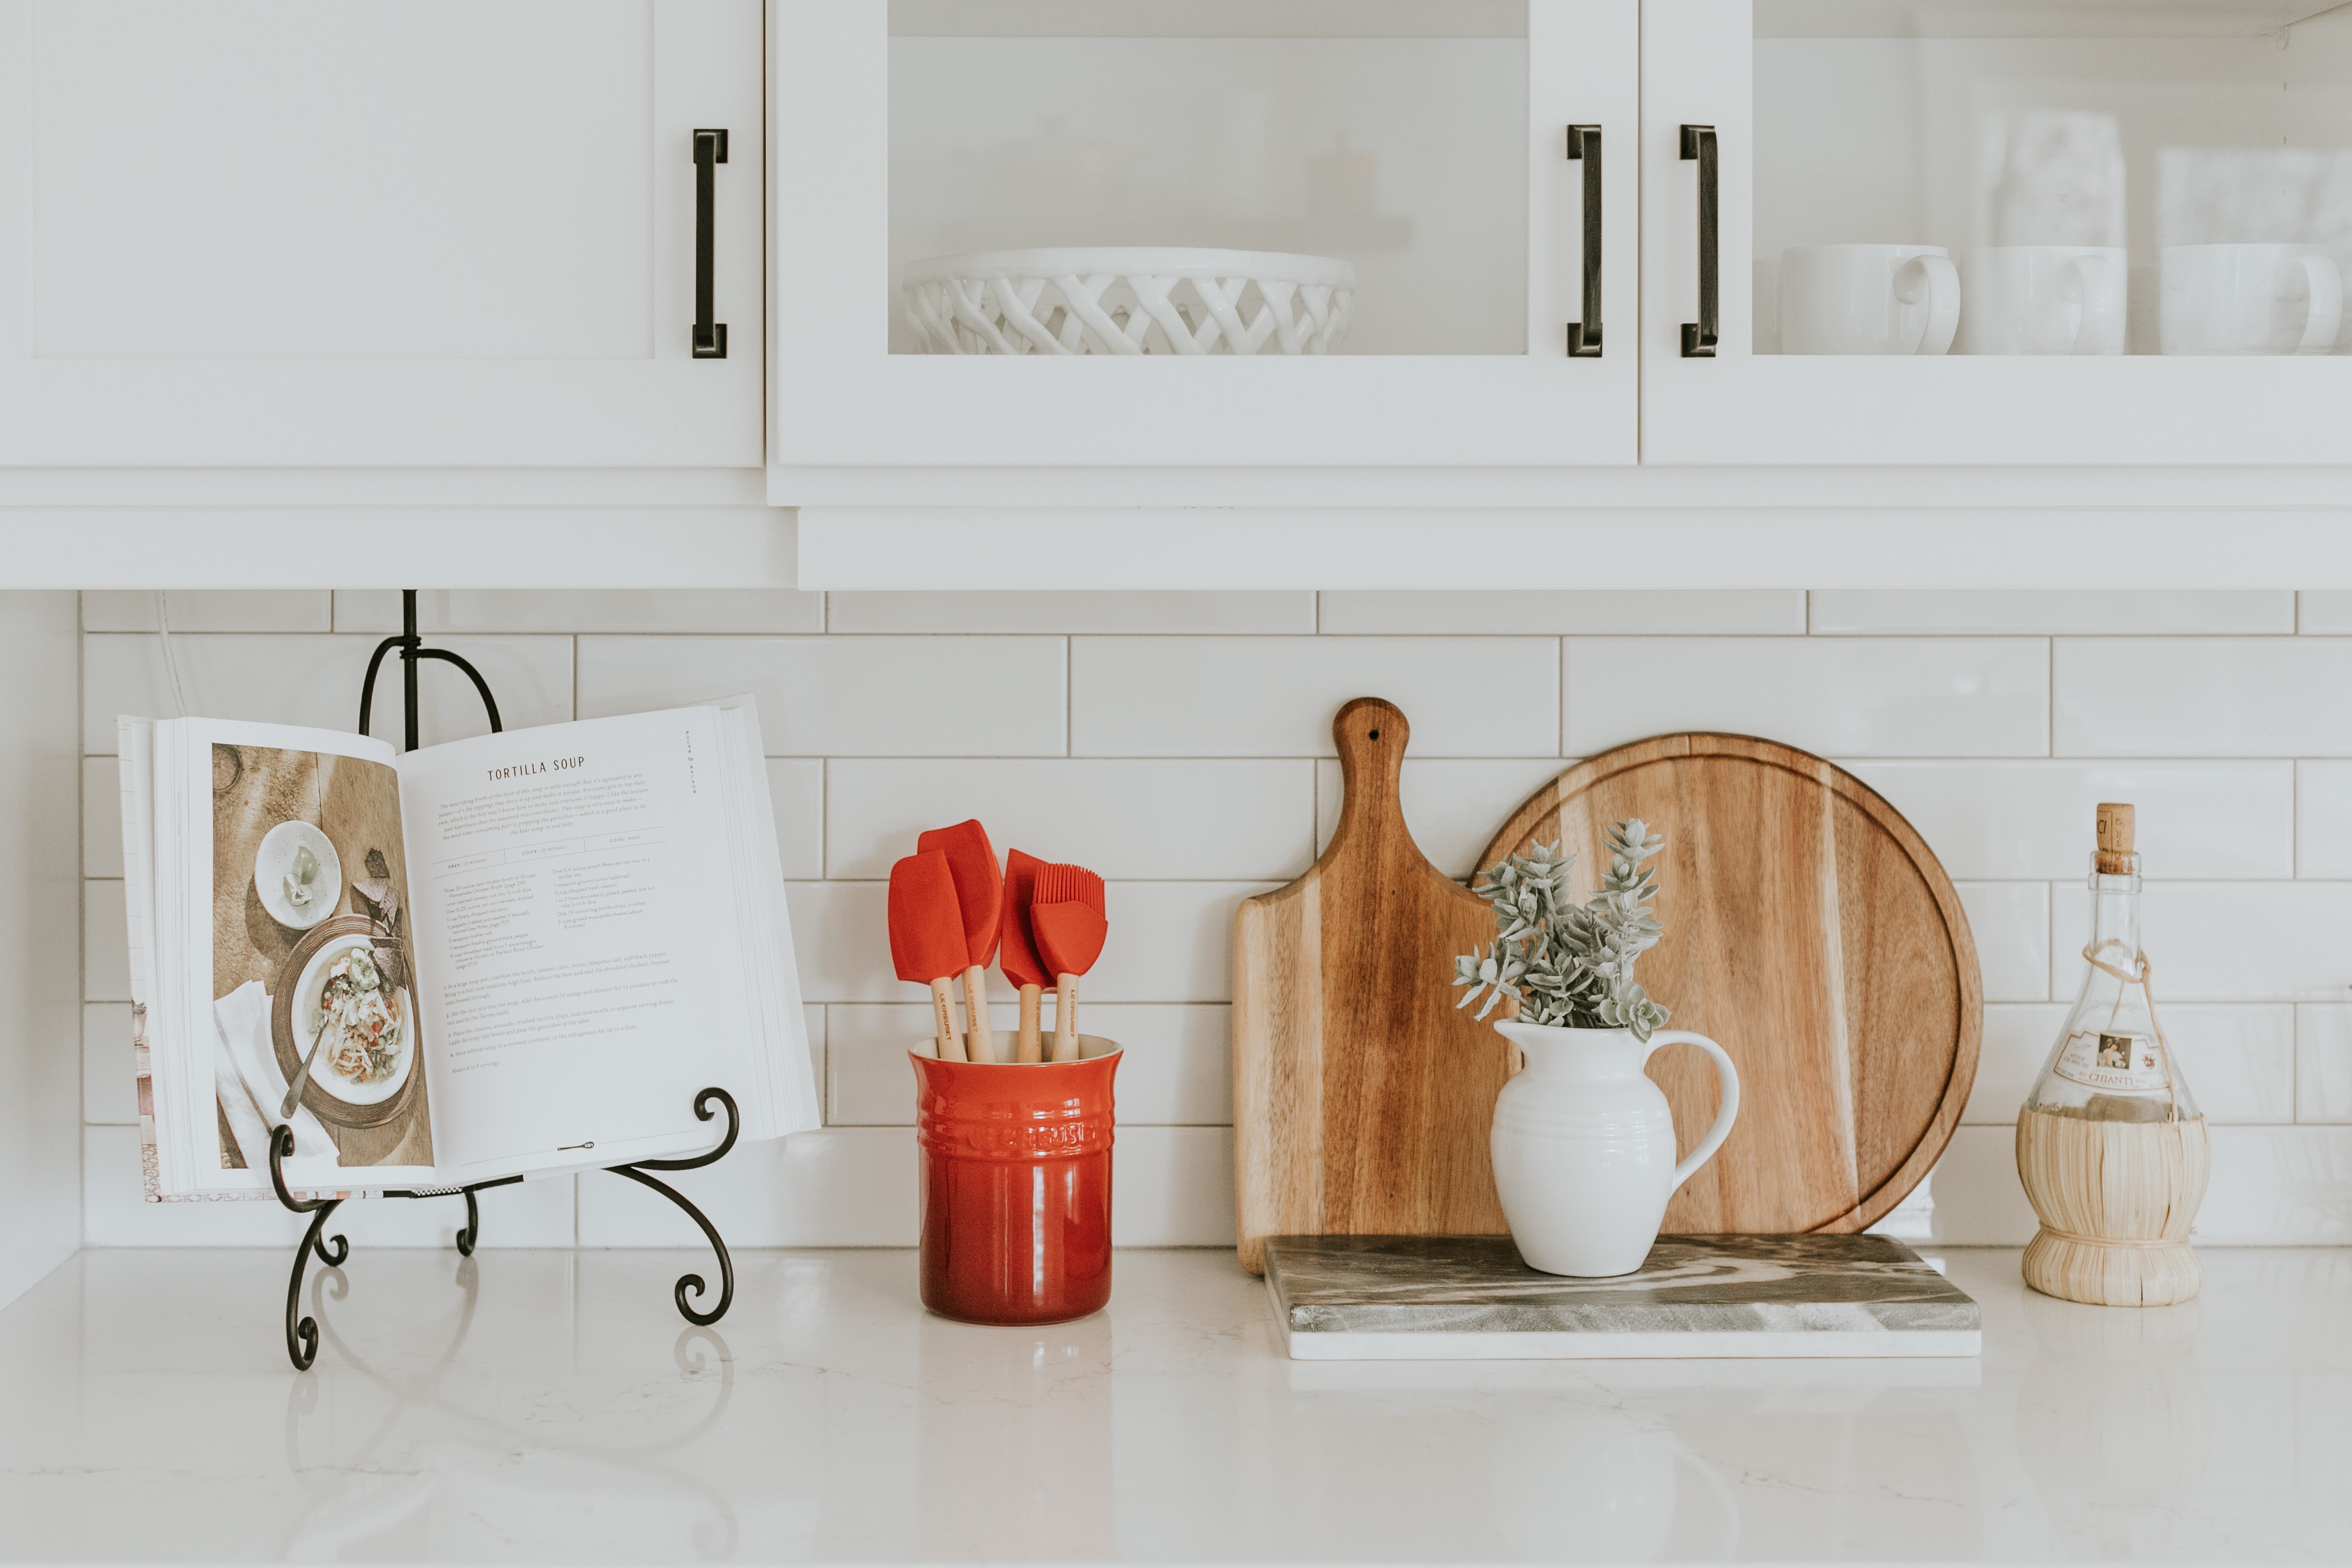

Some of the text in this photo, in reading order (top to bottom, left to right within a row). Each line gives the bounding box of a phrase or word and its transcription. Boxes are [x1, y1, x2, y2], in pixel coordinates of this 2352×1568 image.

[488, 756, 584, 781] TORTILLA SOUP
[449, 799, 474, 807] nourishing
[602, 774, 626, 783] agreeable
[497, 813, 519, 821] seasoned
[487, 979, 520, 990] medium-high
[604, 964, 627, 972] shredded
[939, 993, 952, 1040] LE CREUSET
[2089, 1073, 2133, 1085] CHIANTI
